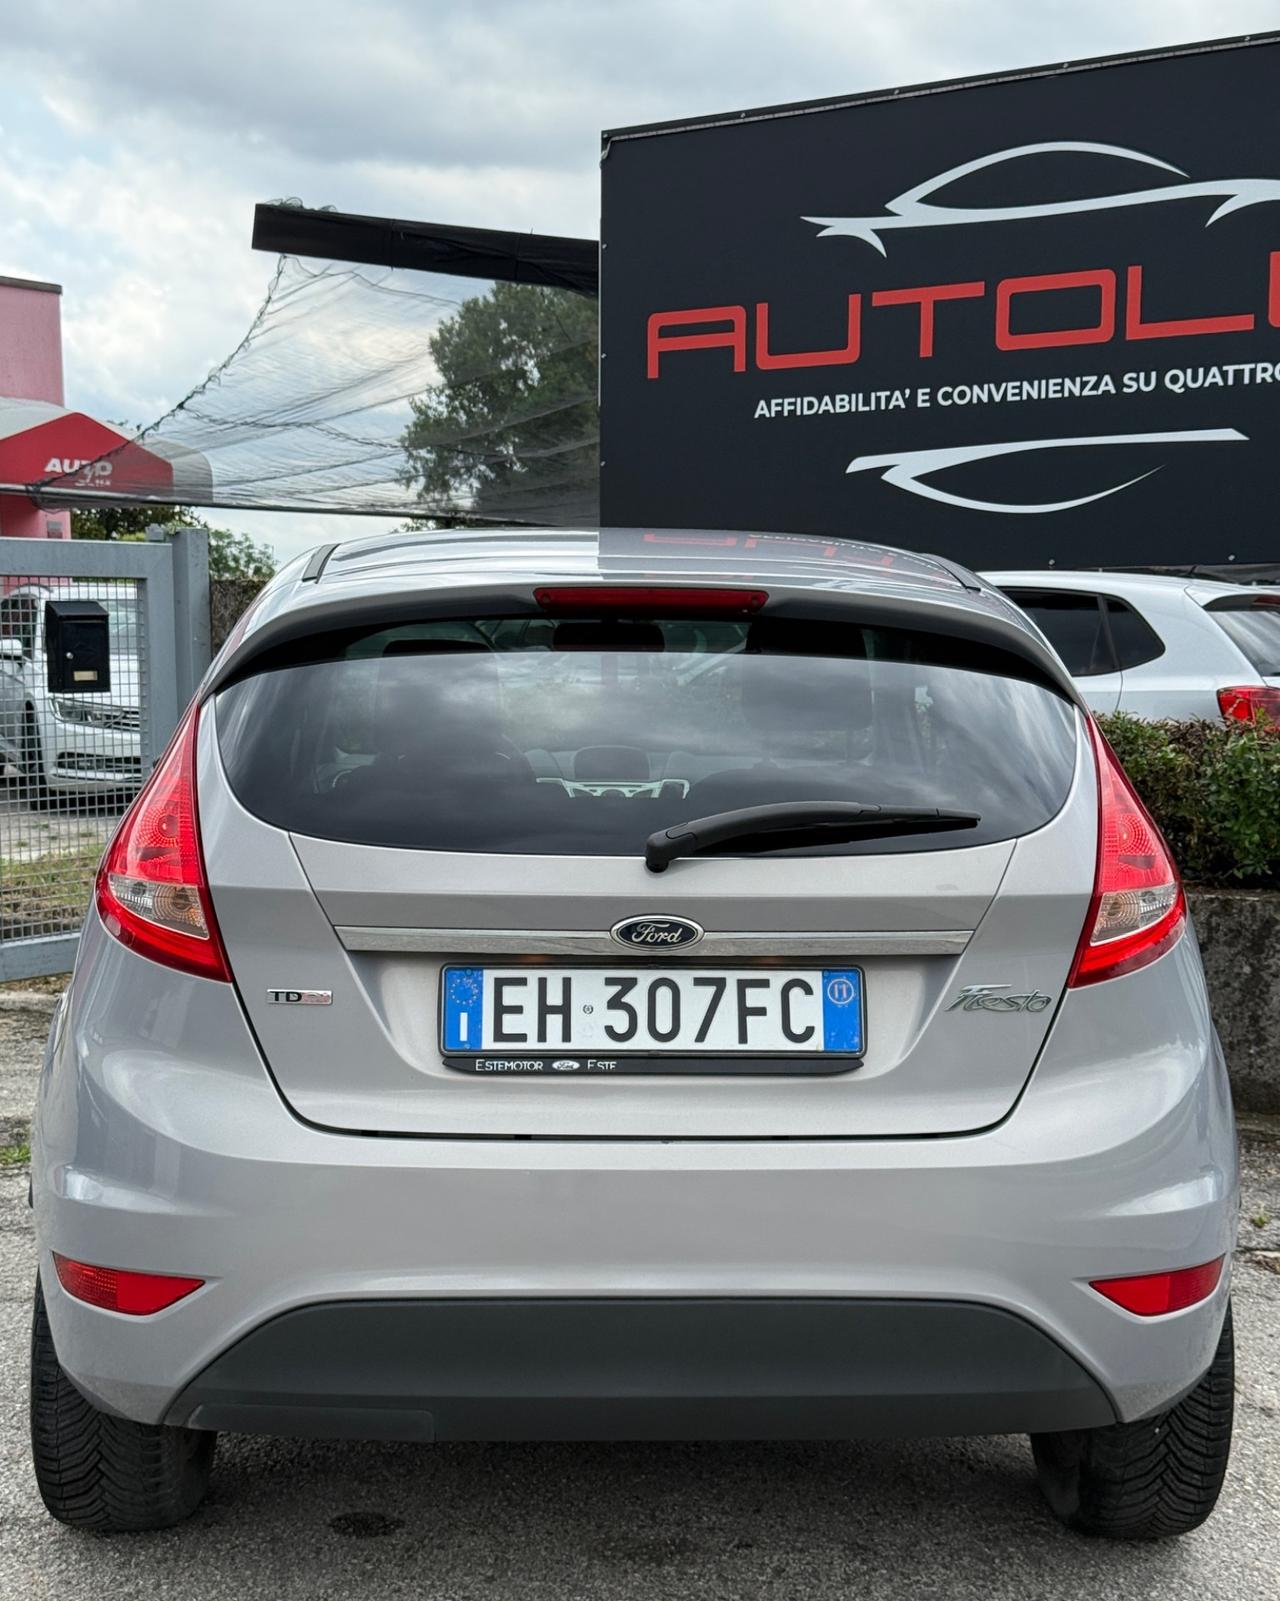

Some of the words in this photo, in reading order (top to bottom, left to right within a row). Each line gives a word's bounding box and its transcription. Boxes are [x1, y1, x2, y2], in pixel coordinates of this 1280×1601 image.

[647, 251, 1280, 379] AUTOL
[753, 388, 911, 418] AFFIDABILITA'
[916, 388, 931, 408] E
[936, 374, 1117, 407] CONVENIENZA
[1122, 371, 1157, 394] SU
[1164, 362, 1280, 394] QUATTR
[631, 922, 684, 944] Ford
[493, 976, 572, 1044] EH
[944, 983, 1053, 1013] Fiesta
